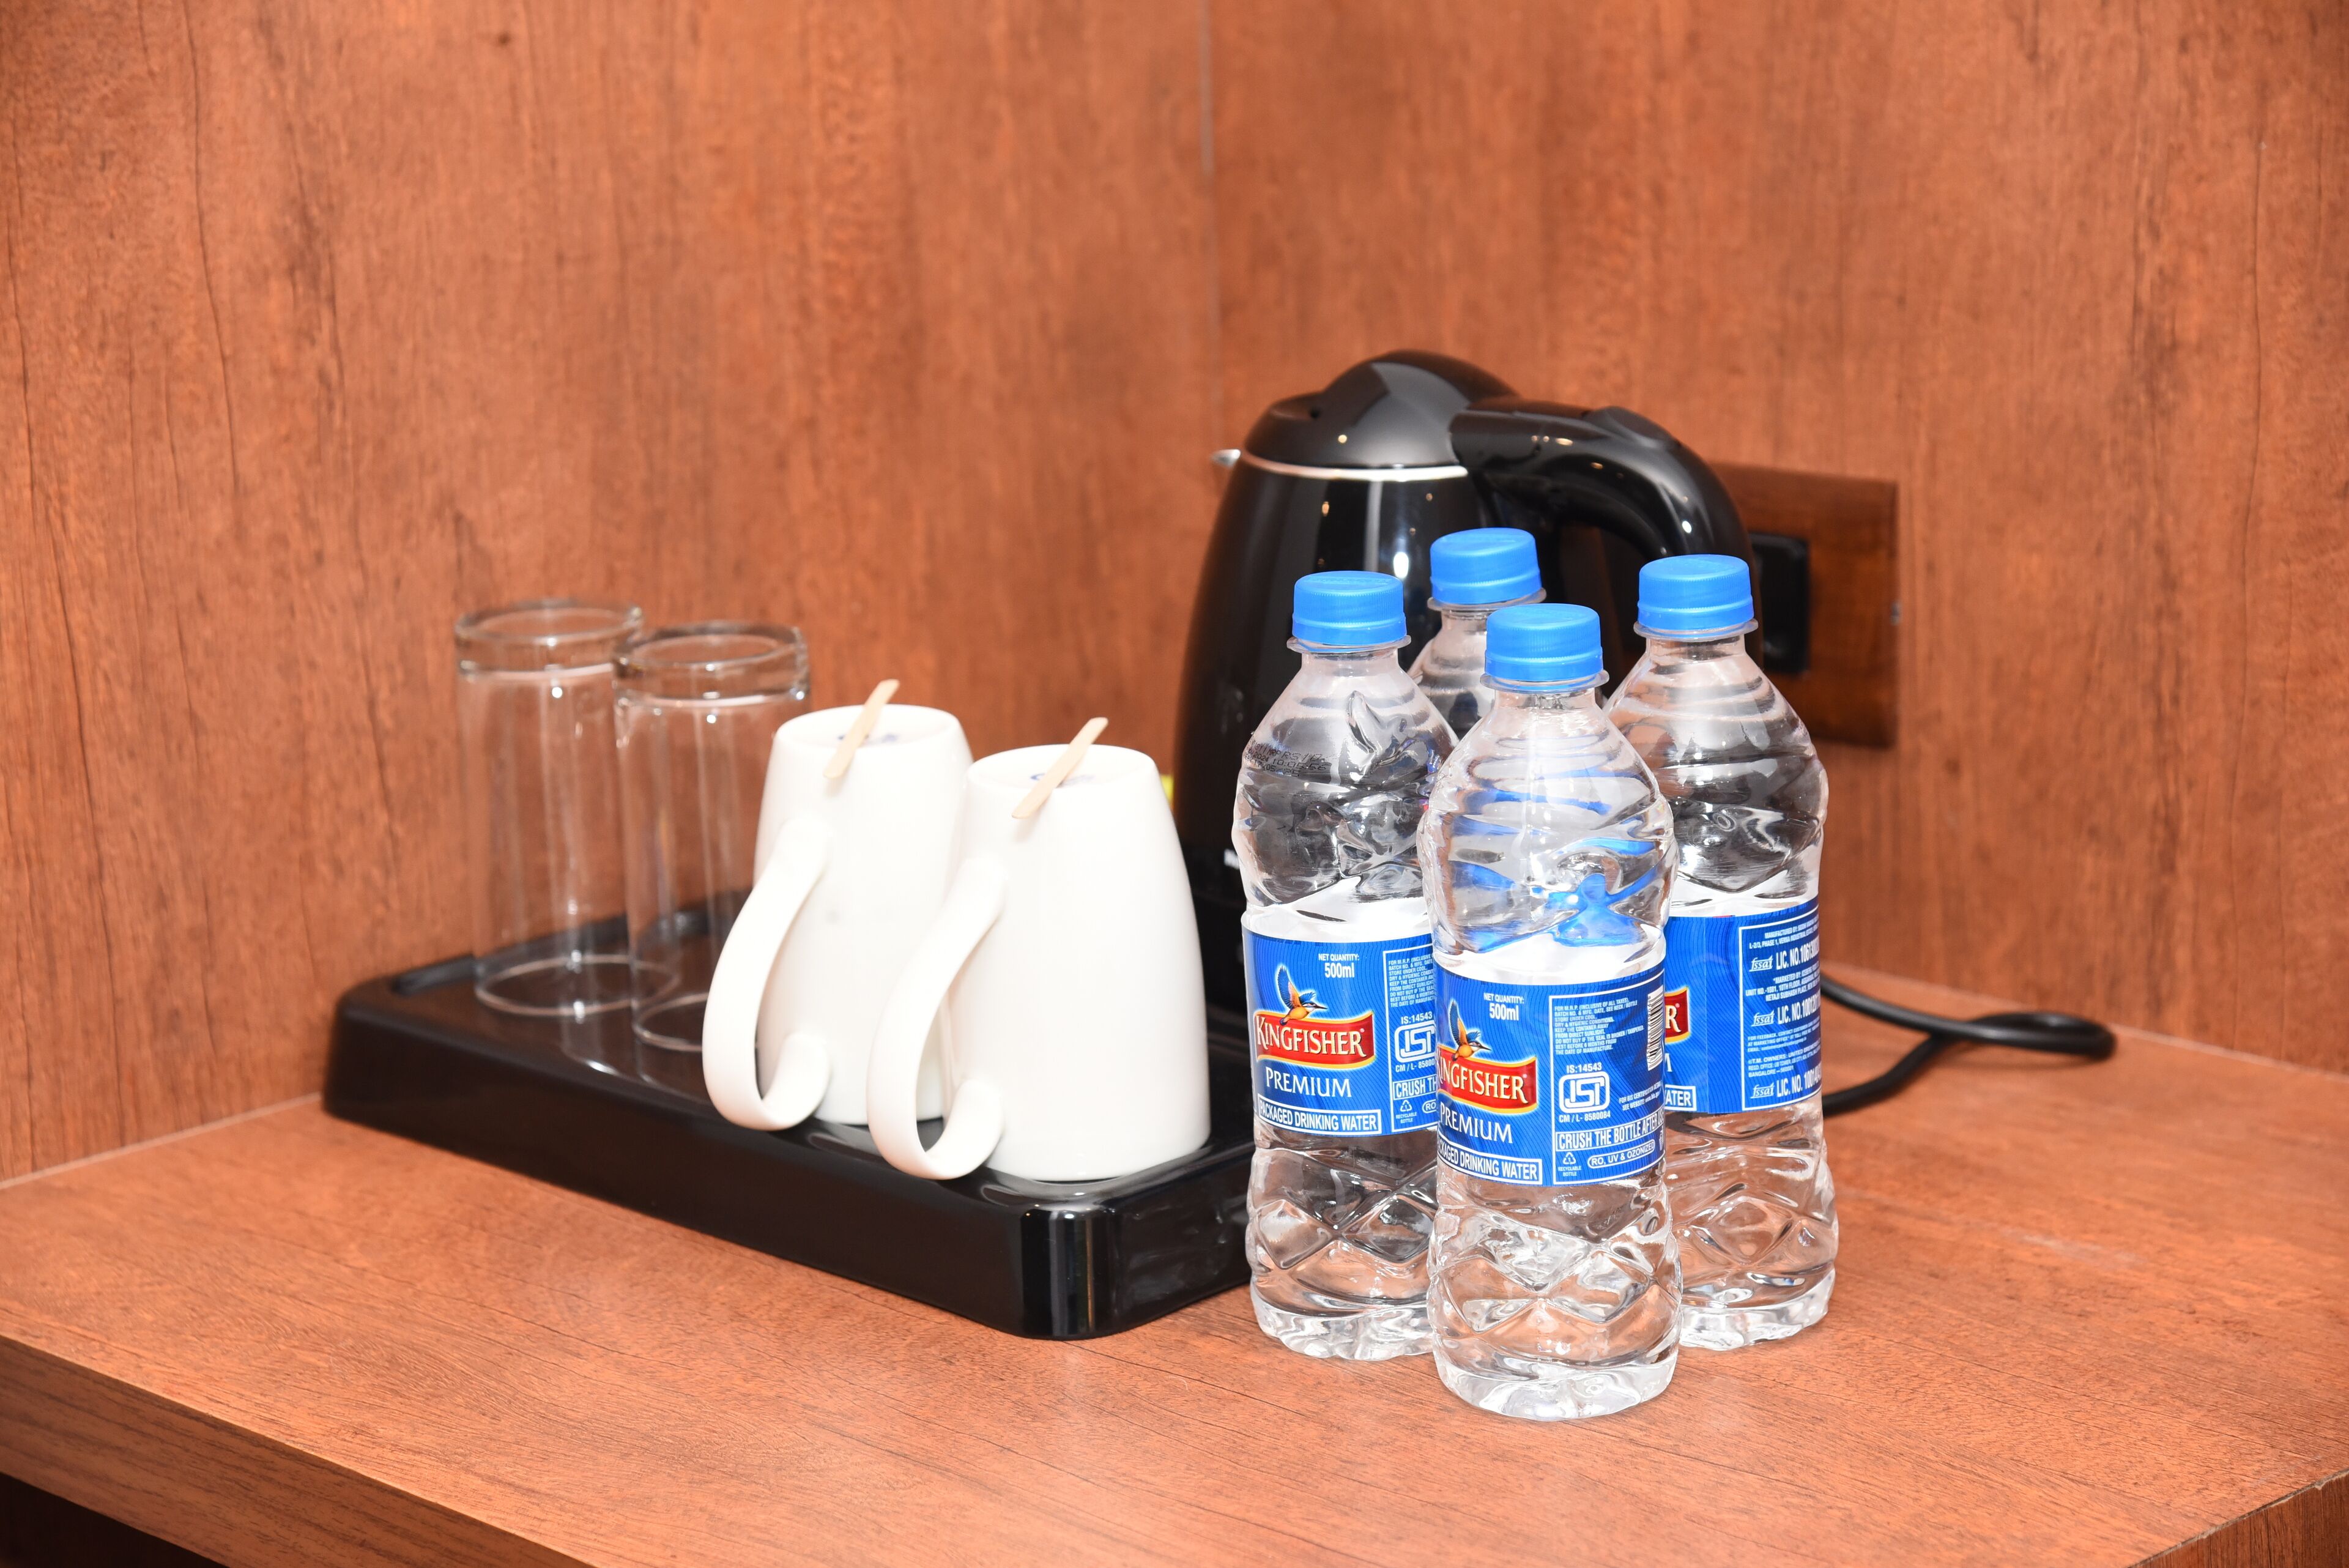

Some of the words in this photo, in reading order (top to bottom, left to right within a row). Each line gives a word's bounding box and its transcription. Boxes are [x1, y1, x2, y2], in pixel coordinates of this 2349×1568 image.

[1325, 963, 1354, 978] 500ml
[1776, 951, 1789, 970] LIC.
[1496, 994, 1524, 1004] QUANTITY:
[1401, 1011, 1432, 1024] IS:14543
[1490, 1003, 1520, 1020] 500ml
[1778, 1005, 1791, 1024] LIC.
[1256, 1016, 1367, 1057] KINGFISHER
[1419, 1058, 1435, 1068] 85800
[1567, 1062, 1601, 1073] IS:14543
[1266, 1066, 1352, 1098] PREMIUM
[1396, 1079, 1426, 1098] CRUSH
[1427, 1076, 1437, 1091] TH
[1438, 1049, 1528, 1104] KINGFISHER
[1776, 1078, 1791, 1097] LIC.
[1792, 1074, 1803, 1094] NO.
[1260, 1100, 1293, 1125] PACKAGED
[1294, 1112, 1338, 1131] DRINKING
[1341, 1115, 1377, 1131] WATER
[1440, 1101, 1513, 1143] PREMIUM
[1585, 1110, 1611, 1121] 8580084
[1560, 1132, 1592, 1149] CRUSH
[1595, 1129, 1611, 1146] THE
[1614, 1121, 1641, 1143] BOTTLE
[1642, 1115, 1658, 1133] AFTER
[1592, 1157, 1606, 1166] RO,
[1608, 1154, 1619, 1163] UV
[1627, 1140, 1655, 1157] OZONIZED
[1460, 1151, 1499, 1175] DRINKING
[1502, 1162, 1537, 1180] WATER
